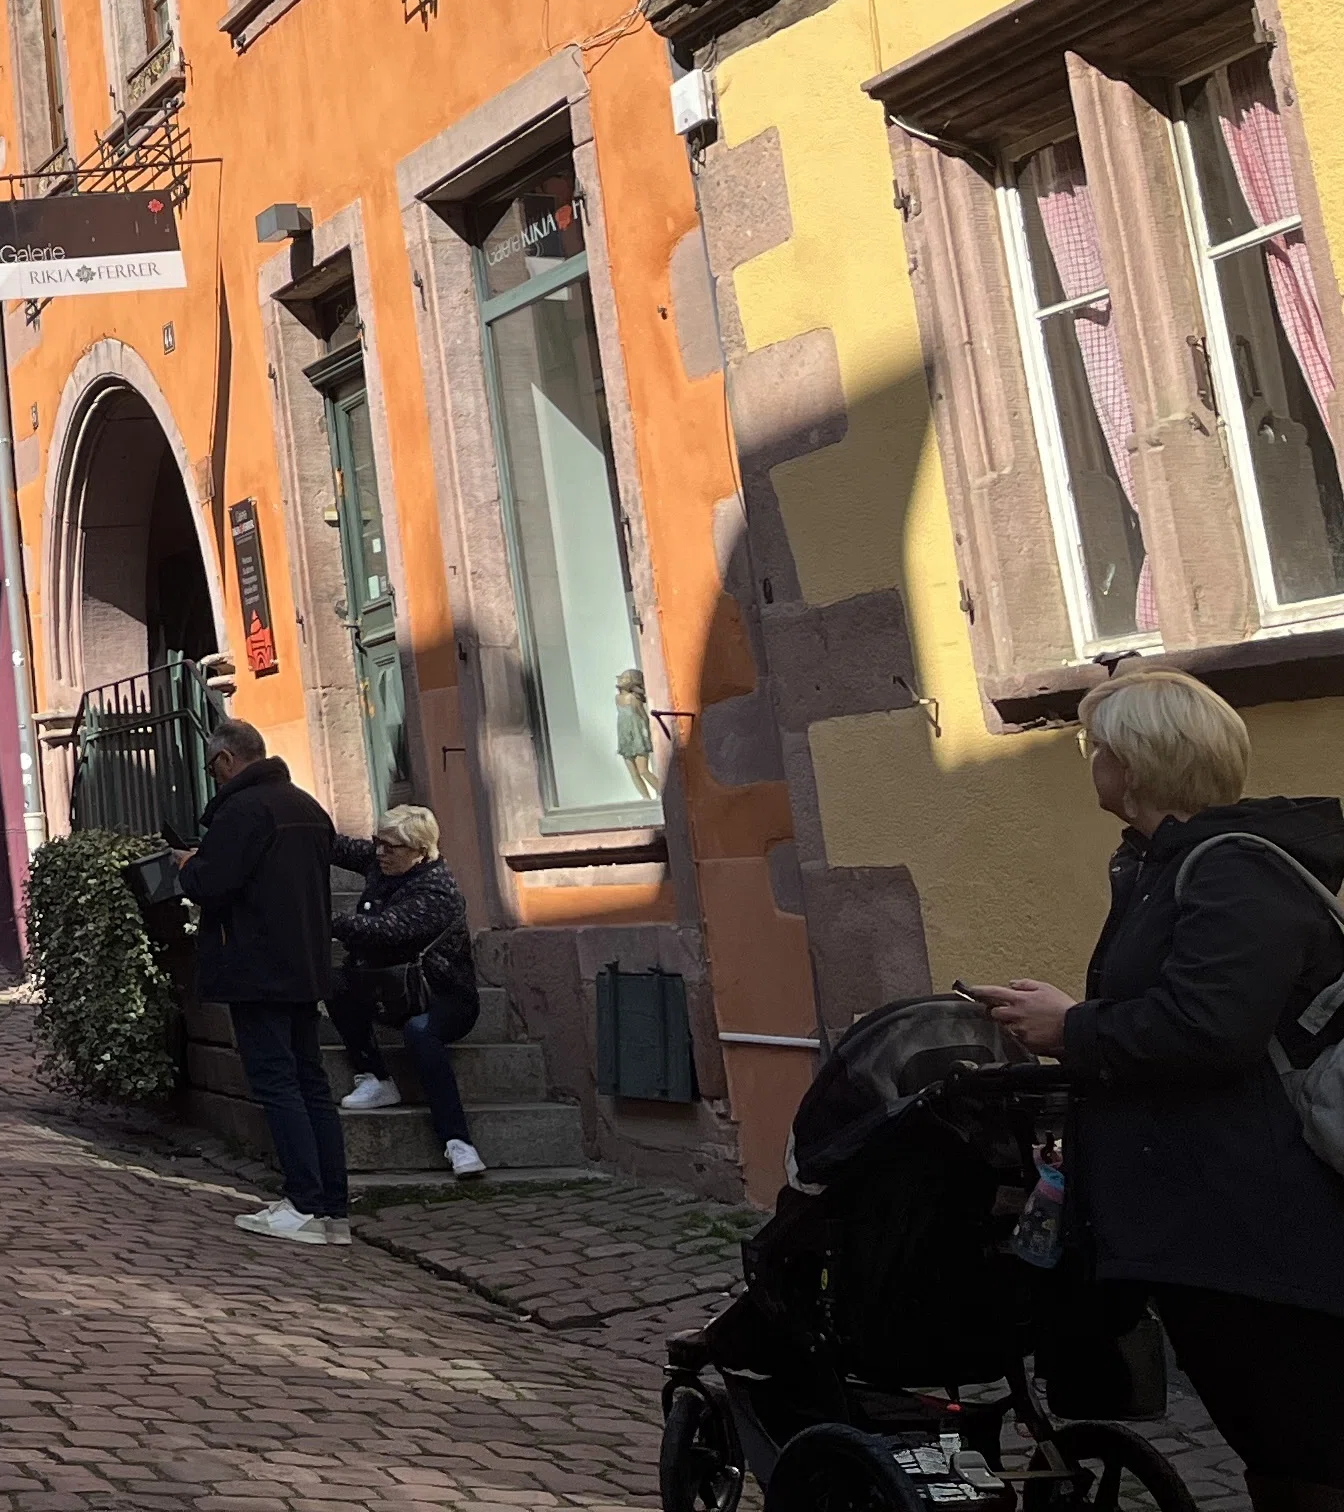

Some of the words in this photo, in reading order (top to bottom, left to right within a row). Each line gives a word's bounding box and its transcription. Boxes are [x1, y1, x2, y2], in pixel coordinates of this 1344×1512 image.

[0, 242, 66, 264] Galerie
[29, 268, 75, 285] RIKIA
[97, 262, 161, 280] FERRER
